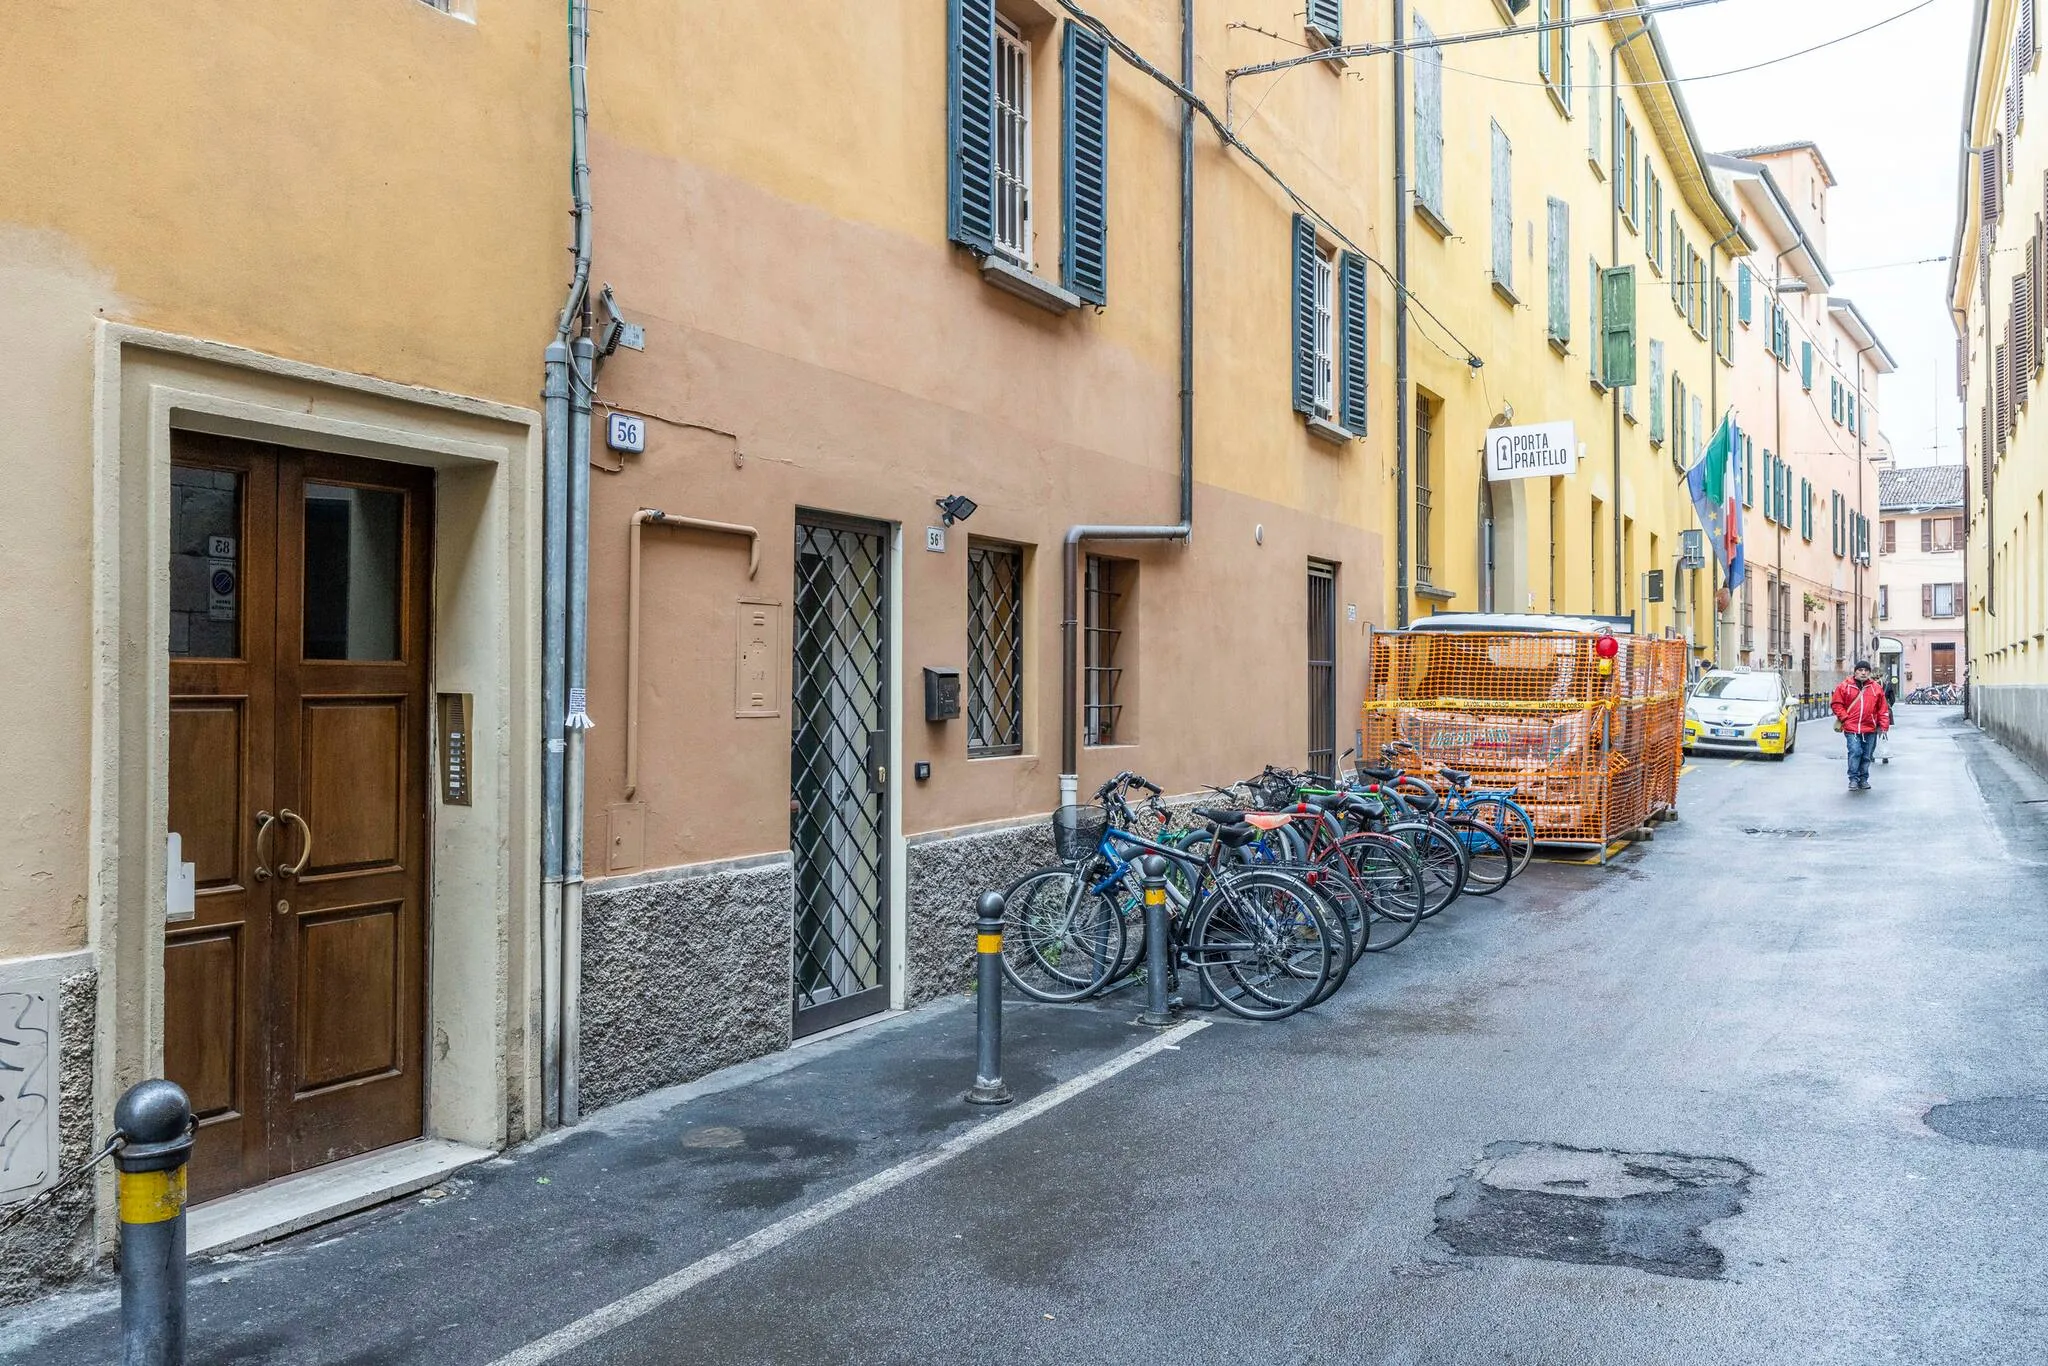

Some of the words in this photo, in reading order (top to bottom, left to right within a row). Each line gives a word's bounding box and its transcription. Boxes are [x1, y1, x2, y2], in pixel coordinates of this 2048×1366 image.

[618, 421, 637, 444] 56
[1513, 432, 1549, 452] PORTA
[1514, 448, 1567, 469] PRATELLO
